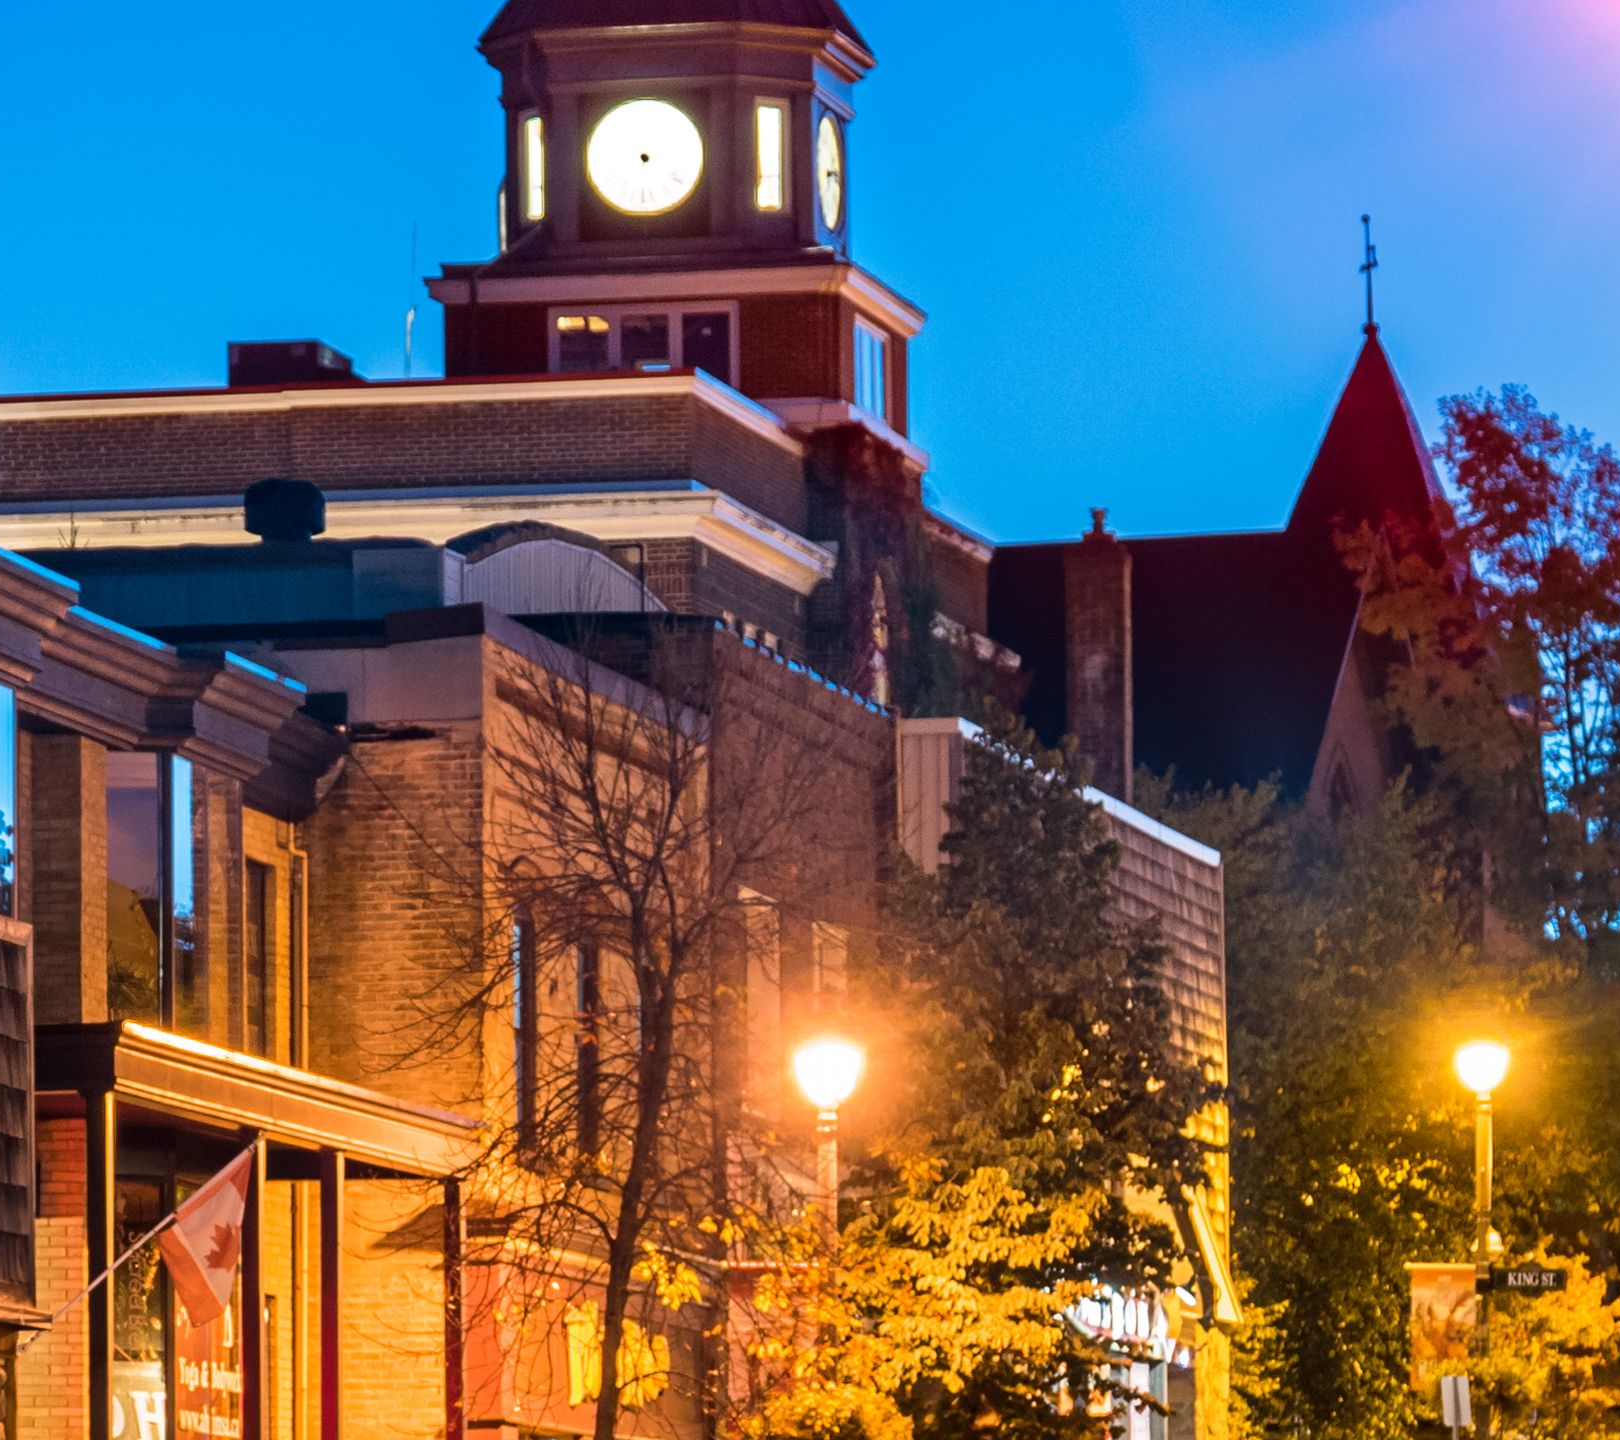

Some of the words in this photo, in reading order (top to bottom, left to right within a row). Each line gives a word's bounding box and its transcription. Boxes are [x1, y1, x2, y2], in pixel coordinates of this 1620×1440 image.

[1507, 1271, 1539, 1287] KING
[178, 1356, 199, 1392] Yoga
[200, 1359, 209, 1389] &
